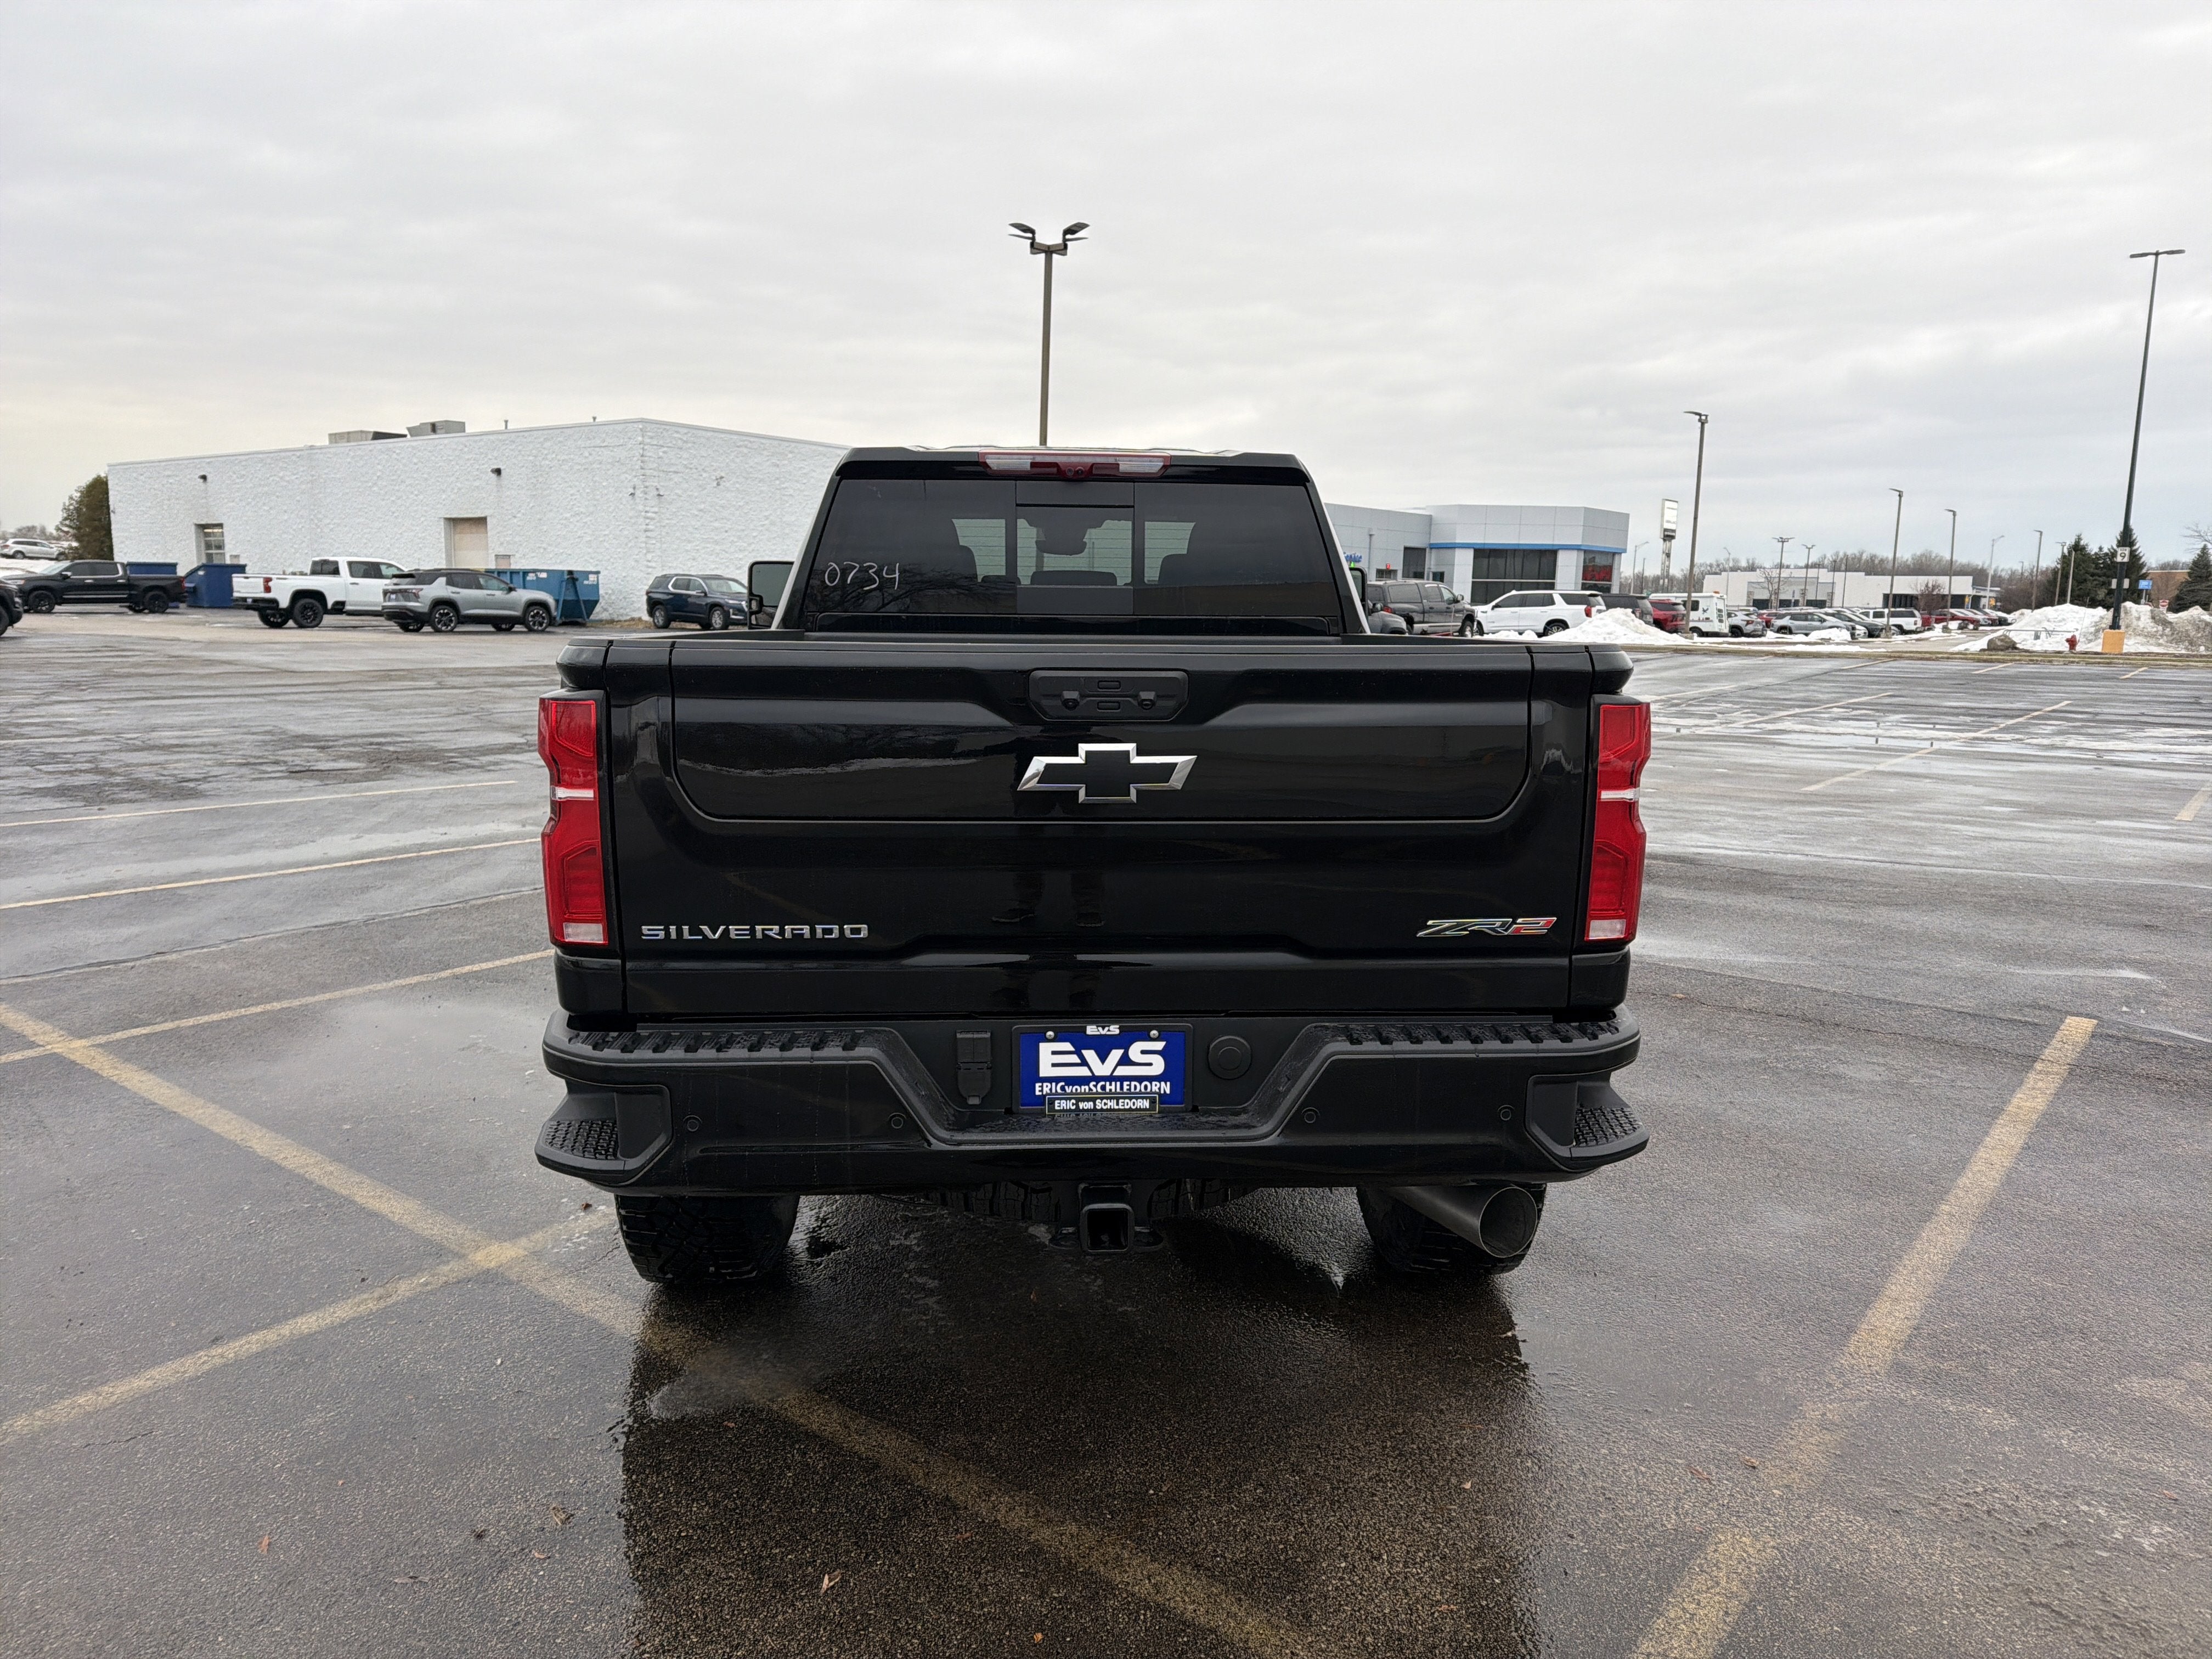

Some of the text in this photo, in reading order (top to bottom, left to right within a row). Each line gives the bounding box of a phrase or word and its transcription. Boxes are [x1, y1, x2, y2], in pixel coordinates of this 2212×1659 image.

[2120, 552, 2126, 561] 9
[825, 561, 900, 590] 0734
[641, 924, 868, 939] SILVERADO
[1417, 917, 1558, 937] ZR2
[1086, 1025, 1120, 1035] EvS
[1039, 1041, 1167, 1077] EvS
[1054, 1099, 1150, 1110] ERIC von SCHLEDORN
